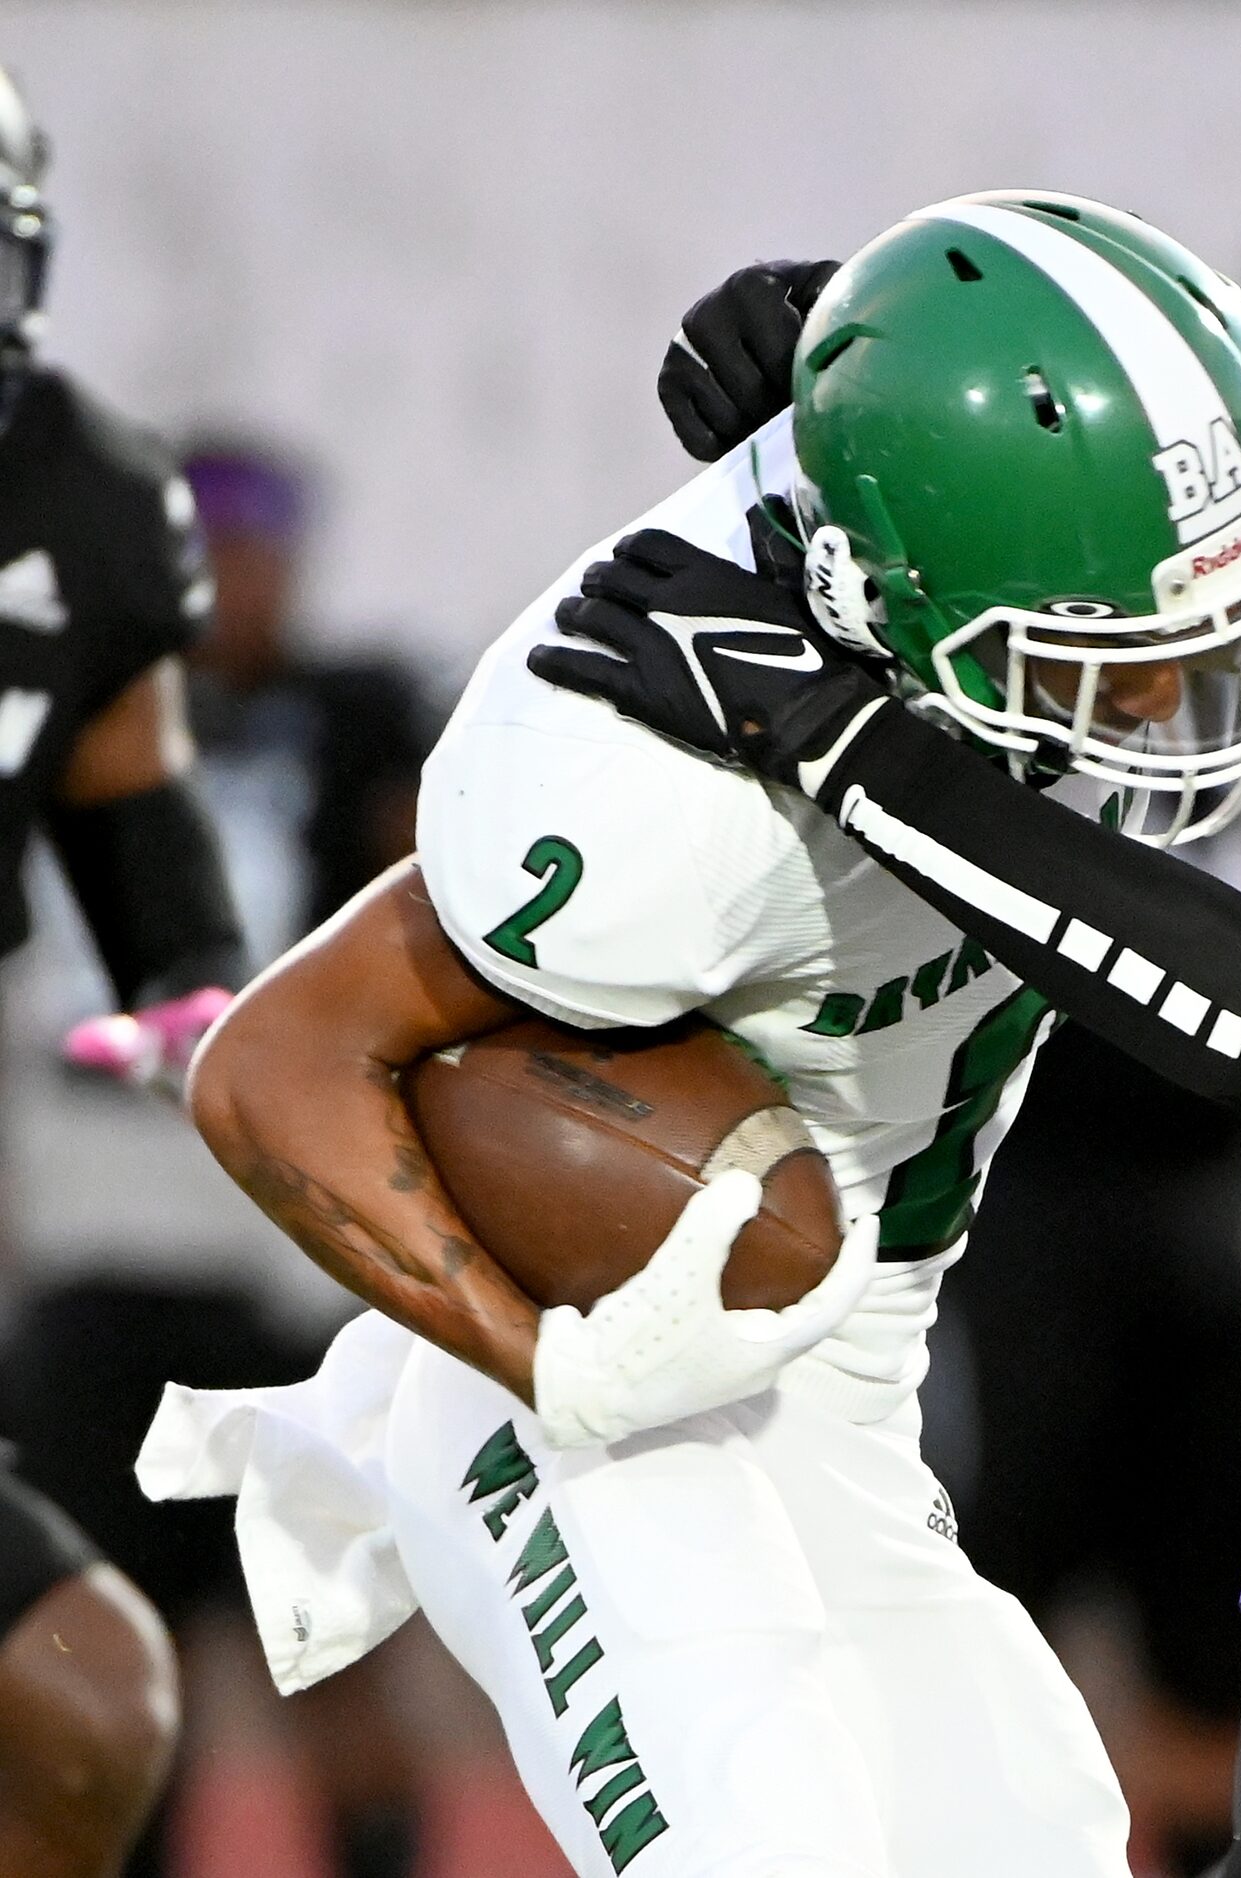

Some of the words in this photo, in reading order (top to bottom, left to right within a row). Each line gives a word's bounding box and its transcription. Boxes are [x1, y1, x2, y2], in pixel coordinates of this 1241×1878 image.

[482, 834, 584, 969] 2
[505, 1503, 605, 1720] WILL
[568, 1694, 670, 1877] WIN
